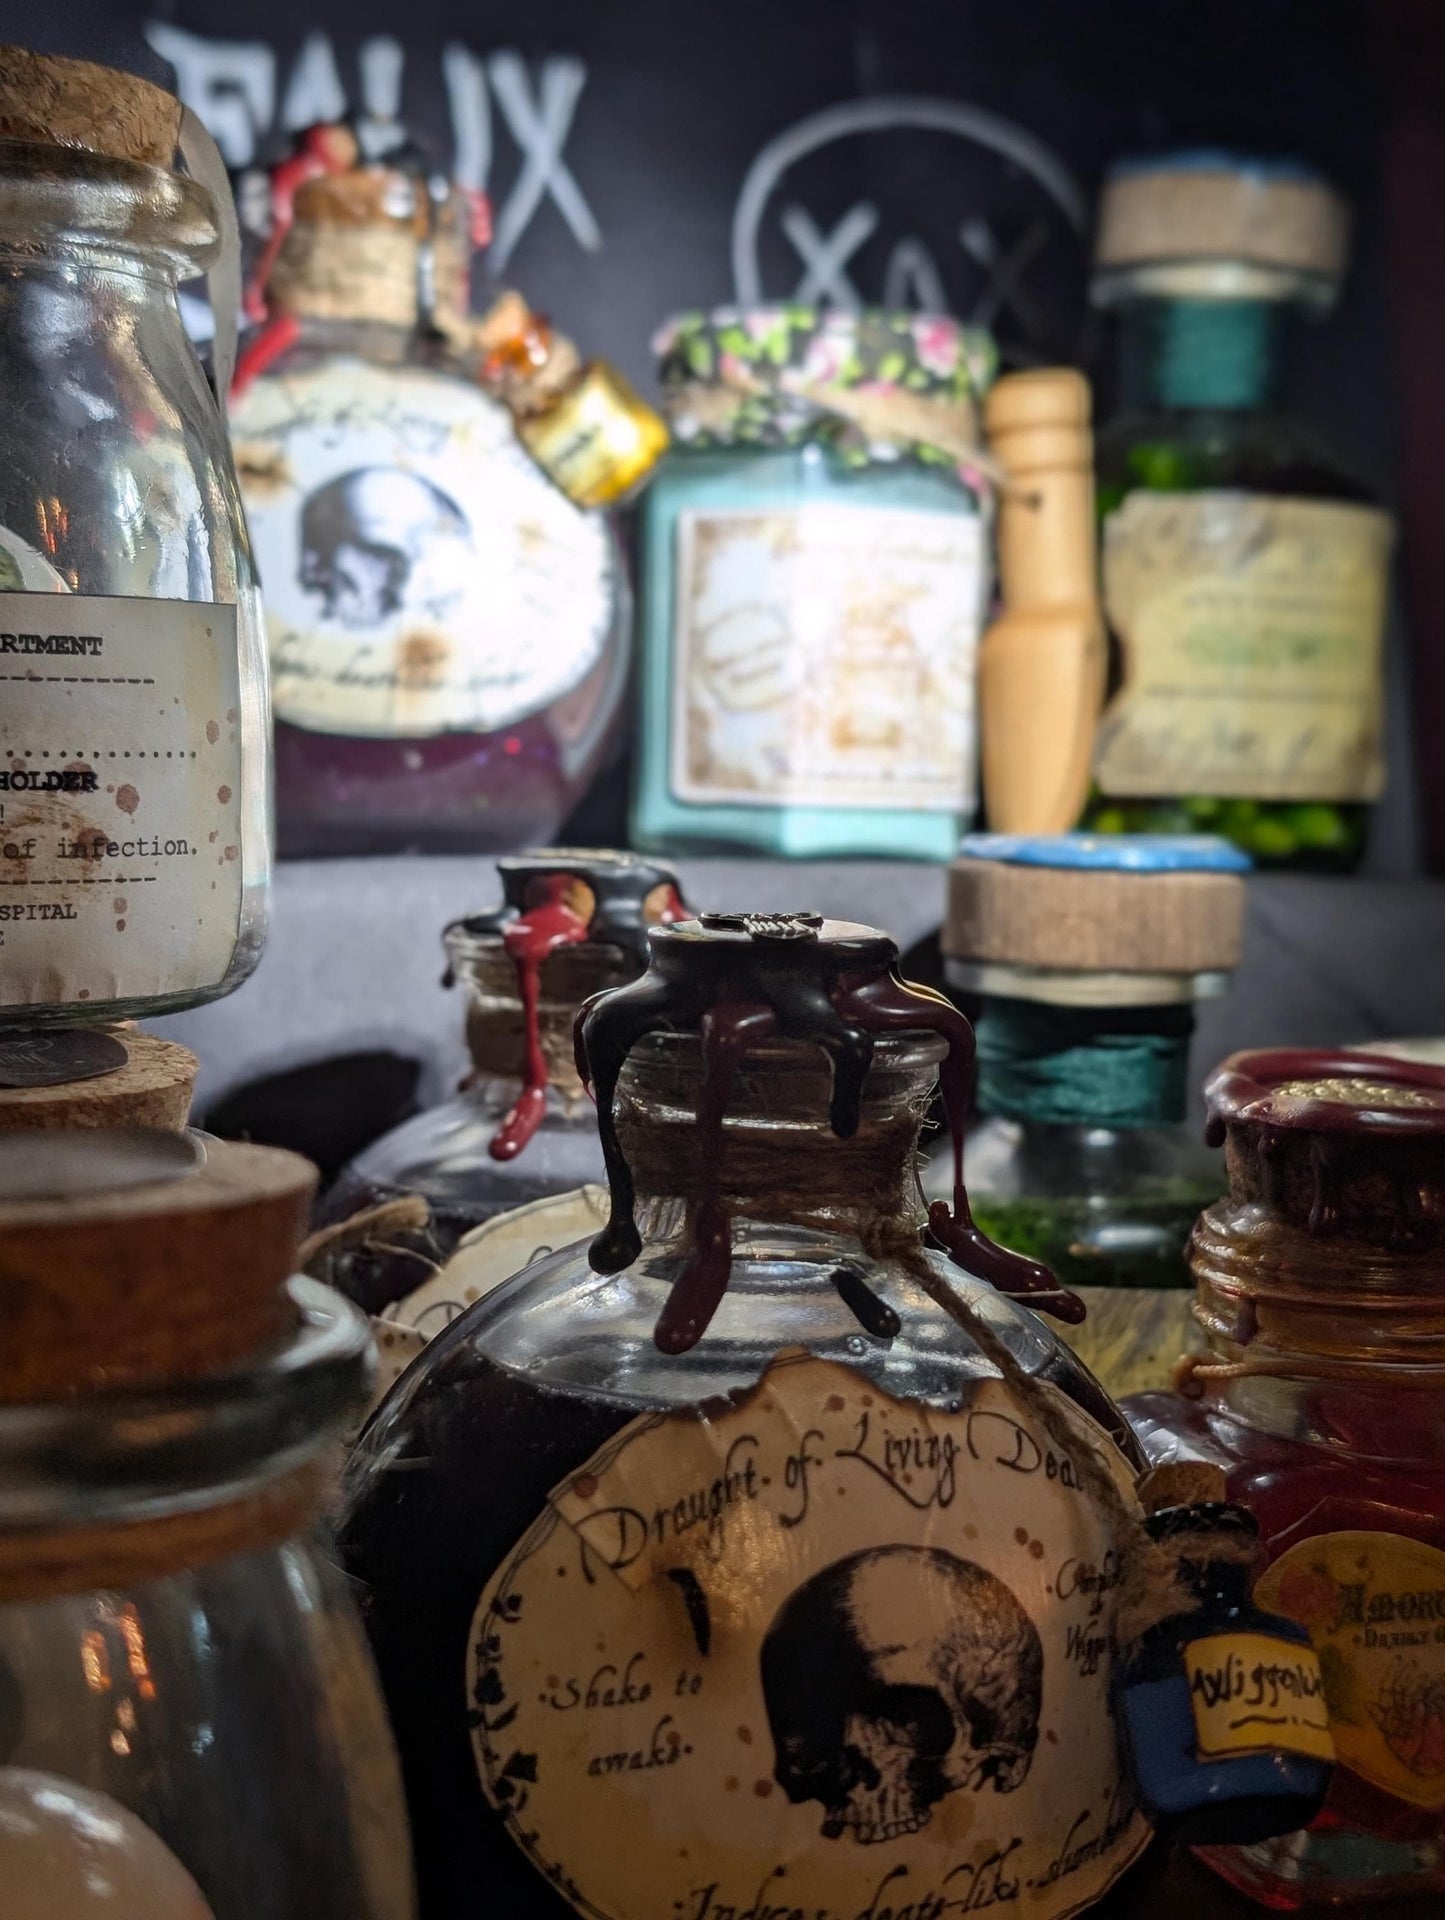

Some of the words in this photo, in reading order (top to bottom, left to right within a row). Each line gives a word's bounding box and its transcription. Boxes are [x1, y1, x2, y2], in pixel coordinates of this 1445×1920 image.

[3, 838, 37, 859] of
[57, 835, 198, 858] infection.
[675, 1669, 704, 1697] to
